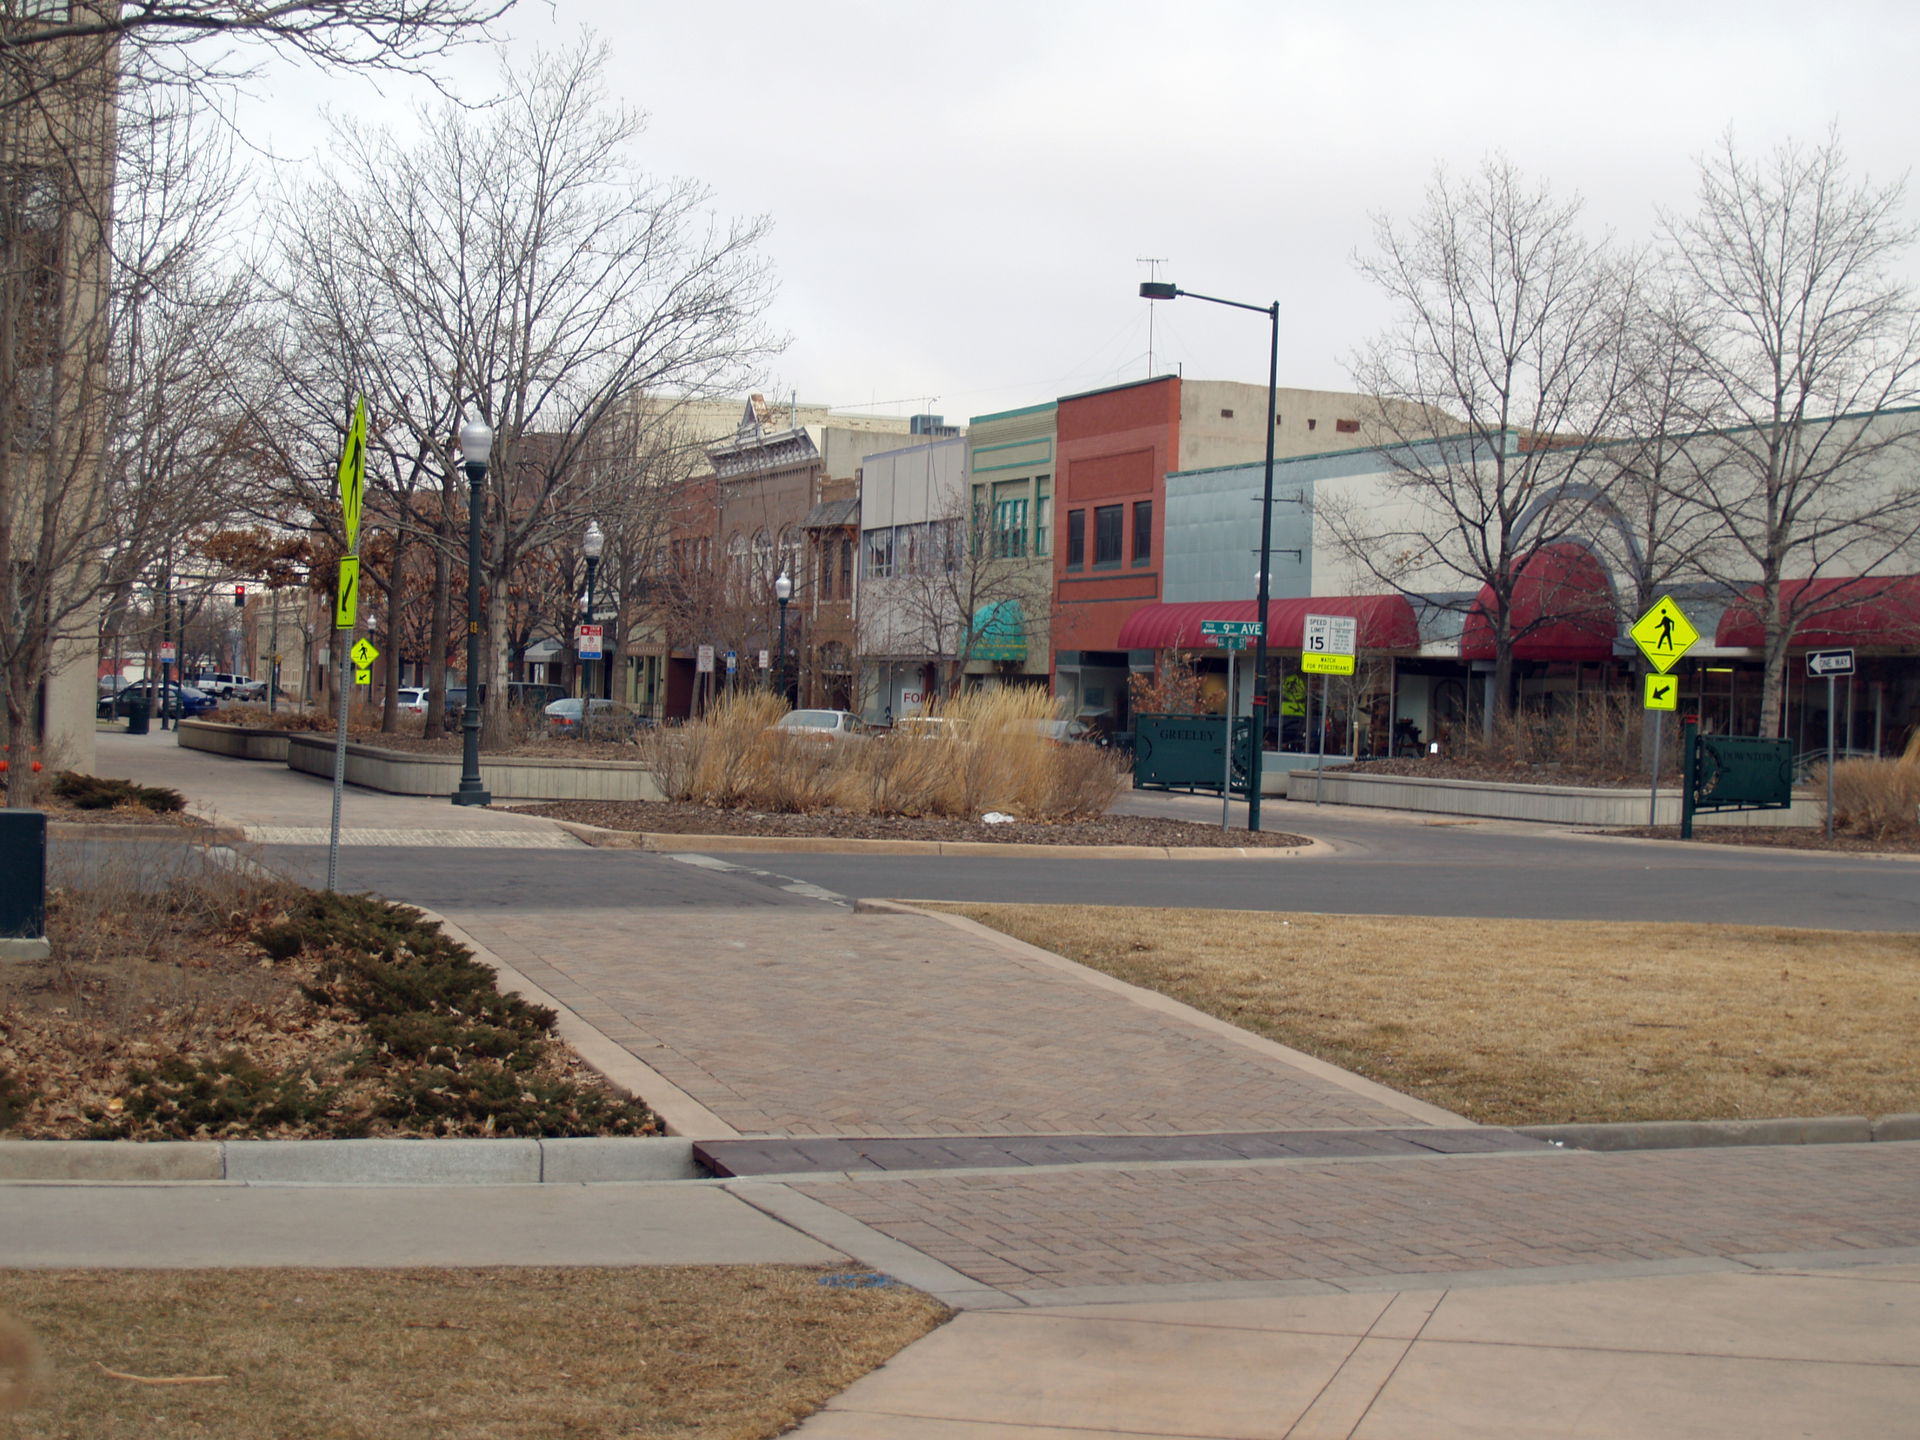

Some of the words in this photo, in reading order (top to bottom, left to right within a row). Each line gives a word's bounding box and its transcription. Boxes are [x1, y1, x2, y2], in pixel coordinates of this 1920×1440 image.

[1309, 618, 1328, 626] SPEED
[1241, 624, 1262, 635] AVE
[1310, 636, 1324, 650] 15
[1819, 658, 1832, 668] ONE
[1835, 656, 1849, 666] WAY
[1160, 728, 1215, 741] GREELEY
[1723, 751, 1782, 761] DOWNTOWN
